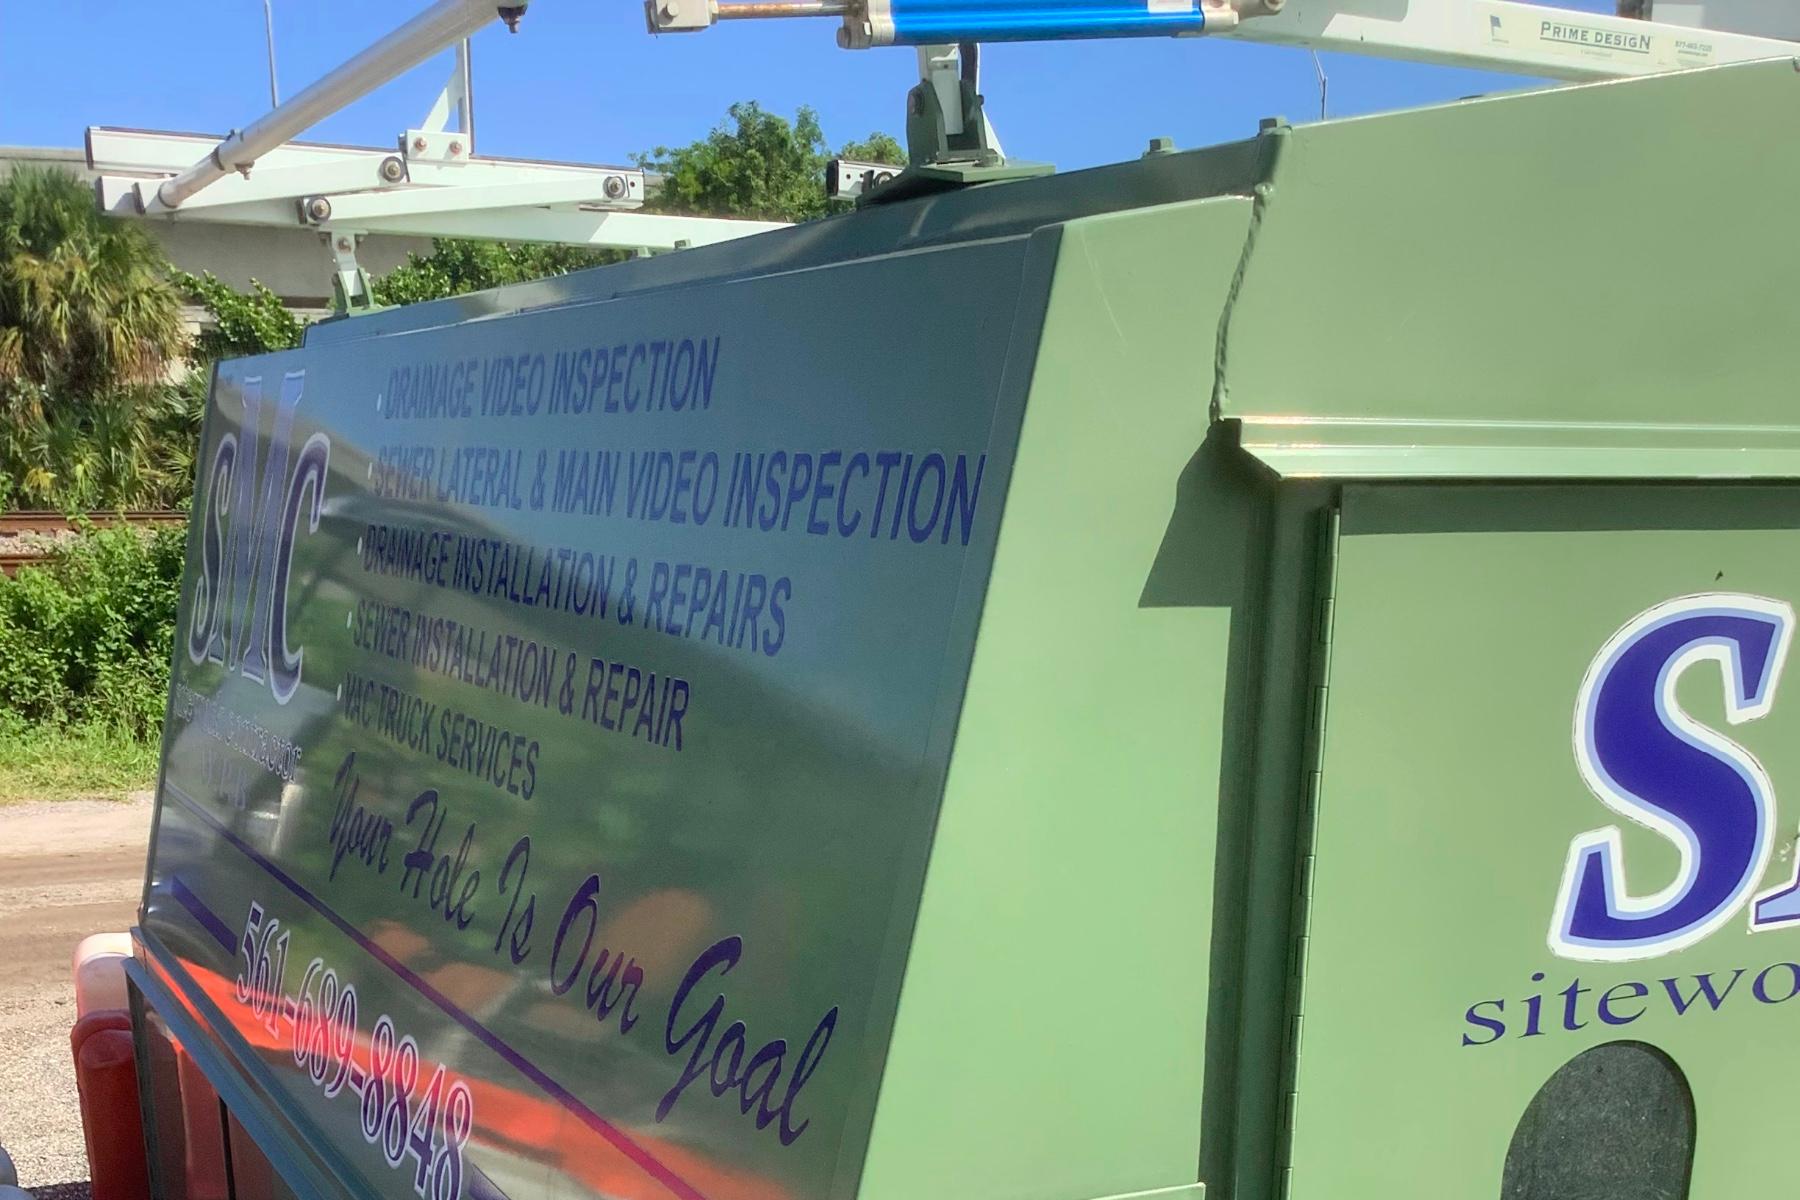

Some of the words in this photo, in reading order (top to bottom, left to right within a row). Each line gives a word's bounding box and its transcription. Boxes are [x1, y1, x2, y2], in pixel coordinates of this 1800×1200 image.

[1539, 20, 1589, 43] PRIME
[1594, 31, 1651, 52] DESIGN
[385, 360, 478, 420] DRAINAGE
[481, 354, 545, 417] VIDEO
[547, 336, 721, 415] INSPECTION
[373, 446, 434, 500] SEWER
[436, 447, 522, 511] LATERAL
[529, 449, 548, 511] &
[551, 449, 621, 517] MAIN
[626, 449, 719, 526] VIDEO
[722, 449, 987, 547] INSPECTION
[363, 525, 452, 588] DRAINAGE
[452, 533, 615, 620] INSTALLATION
[616, 557, 638, 626] &
[643, 560, 792, 658] REPAIRS
[344, 671, 375, 729] VAC
[377, 683, 437, 754] TRUCK
[436, 707, 540, 802] SERVICES
[353, 599, 411, 661] SEWER
[411, 612, 557, 709] INSTALLATION
[558, 651, 577, 717] &
[580, 657, 691, 752] REPAIR
[328, 751, 393, 882] Your
[399, 789, 481, 931] Hole
[494, 835, 536, 965] Is
[549, 873, 644, 1036] Our
[654, 935, 840, 1147] Goal
